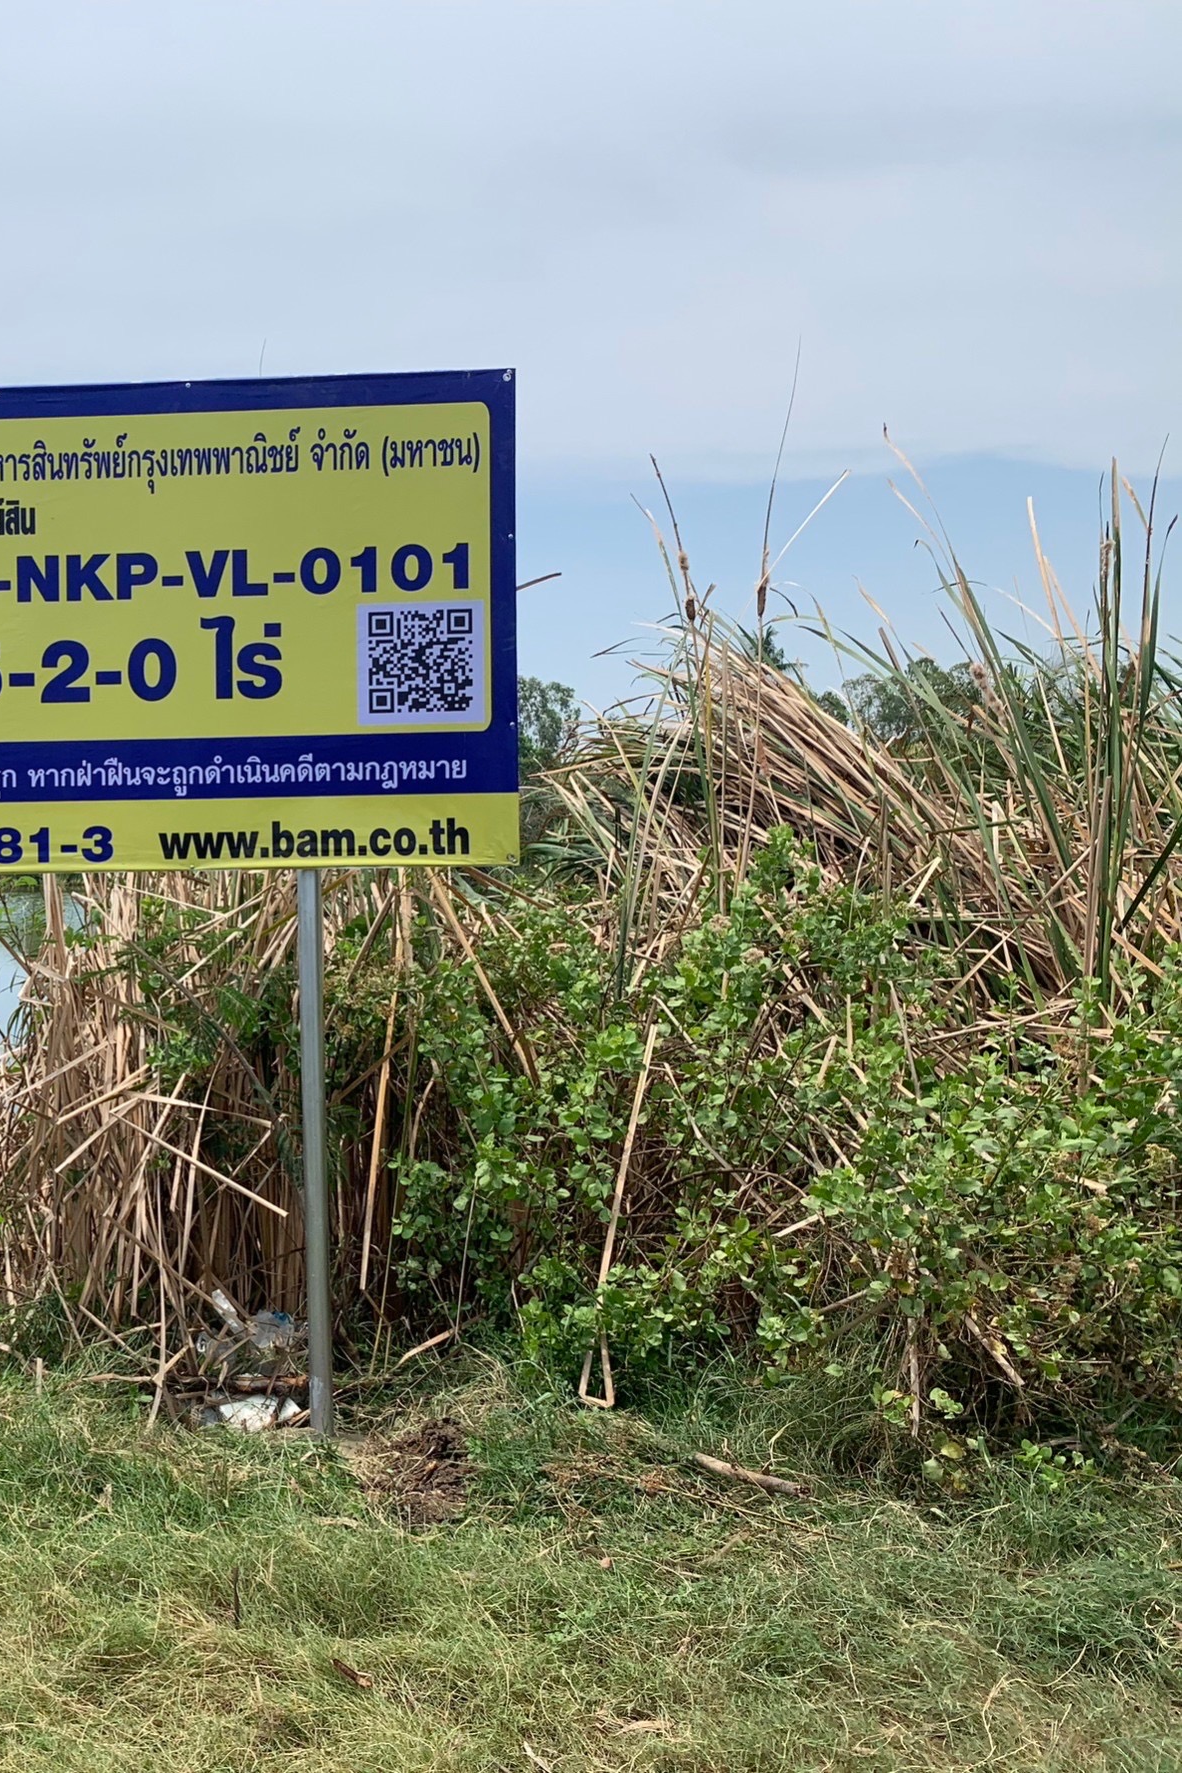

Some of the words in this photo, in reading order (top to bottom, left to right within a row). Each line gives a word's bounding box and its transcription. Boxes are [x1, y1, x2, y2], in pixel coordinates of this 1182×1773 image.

[310, 428, 370, 471] จำกัด
[381, 432, 480, 476] (มหาชน)
[200, 615, 282, 699] ไร่
[27, 753, 467, 796] หากฝ่าฝืนจะถูกดำเนินคดีตามกฎหมาย
[158, 817, 469, 860] www.bam.co.th
